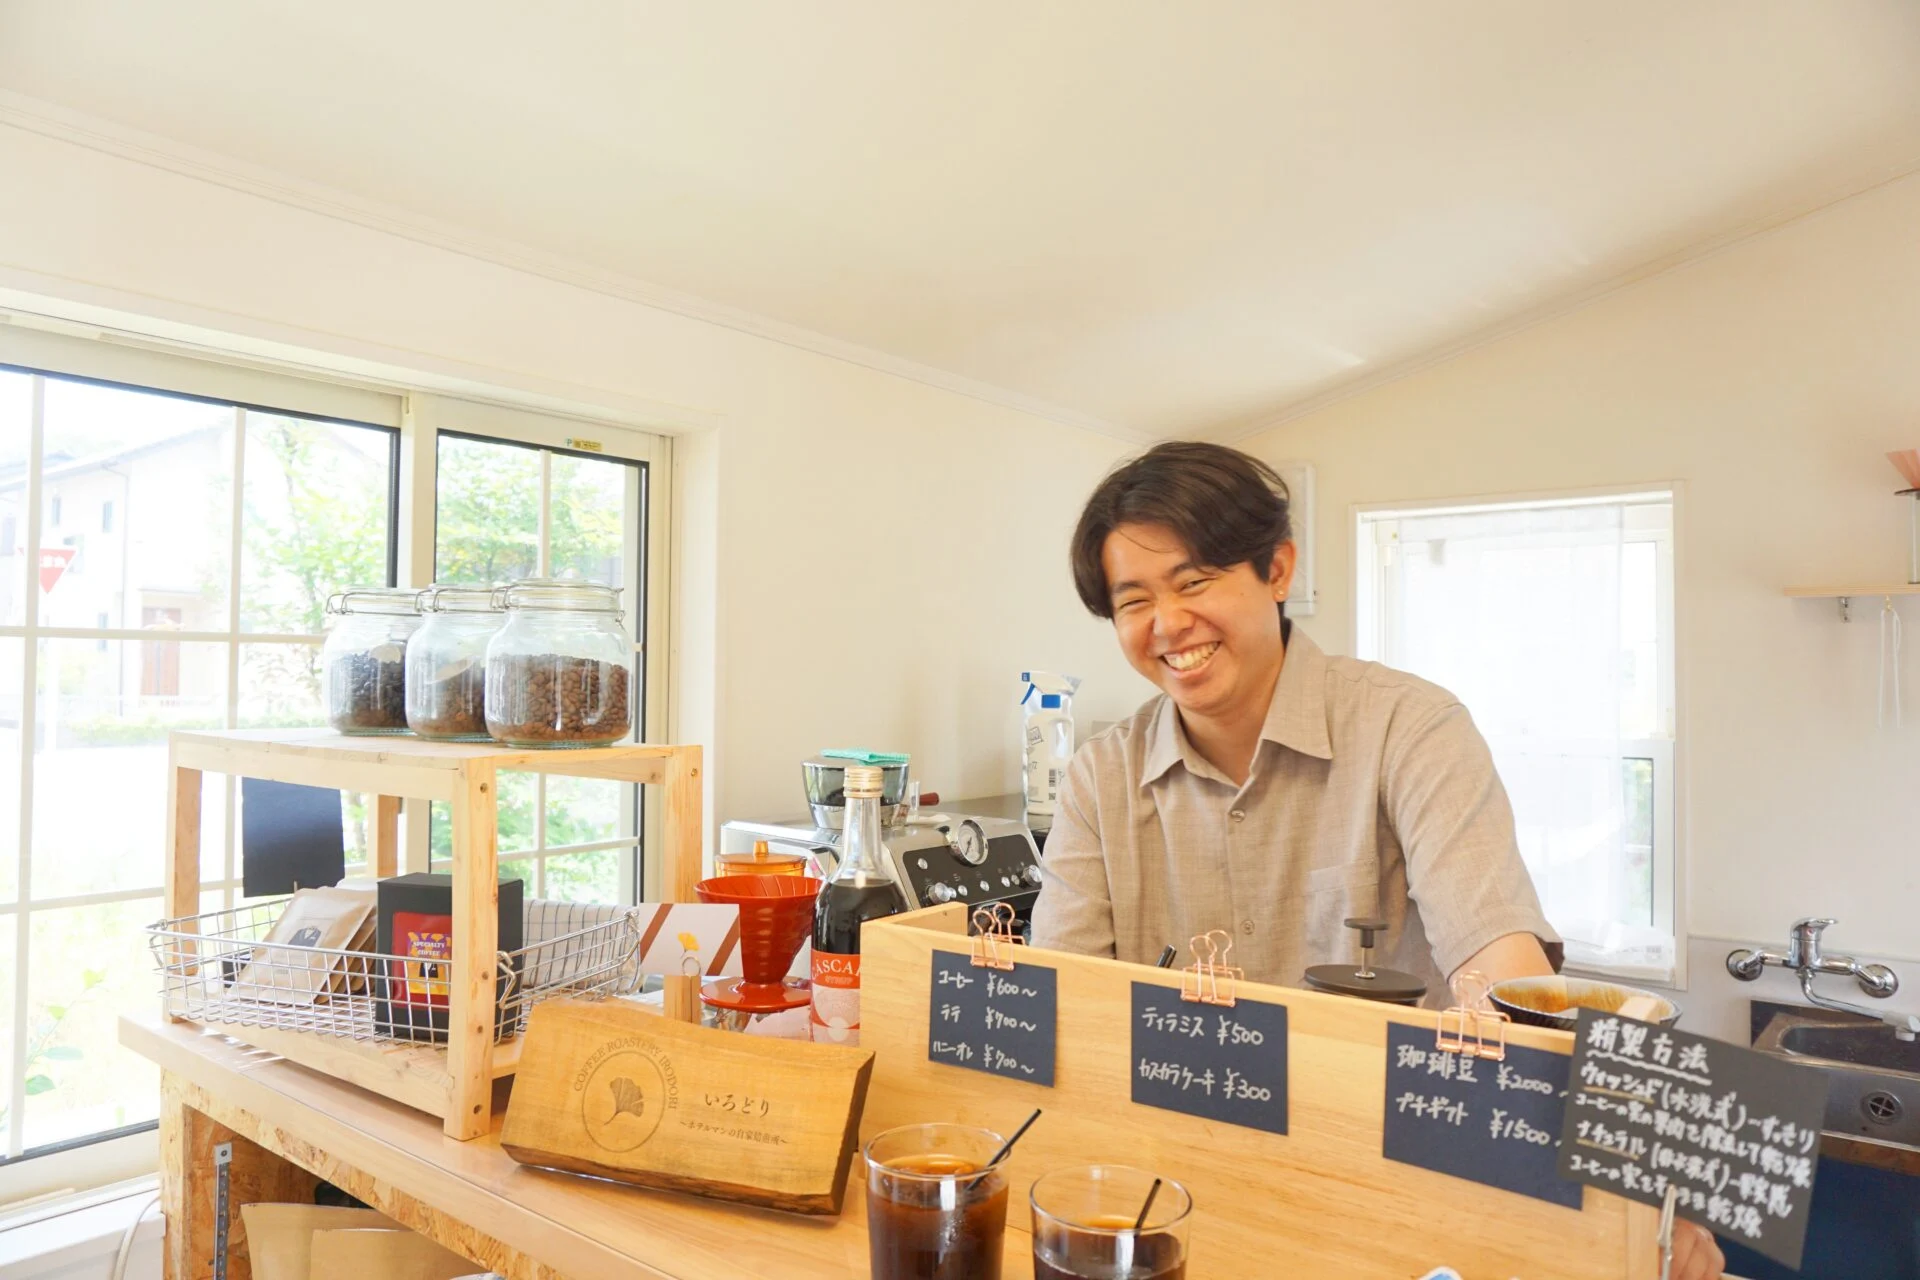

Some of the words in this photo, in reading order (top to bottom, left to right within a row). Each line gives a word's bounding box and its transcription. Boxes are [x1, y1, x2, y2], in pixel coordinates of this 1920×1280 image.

[938, 970, 974, 990] コーヒー
[940, 1003, 962, 1023] ラテ
[1141, 1006, 1205, 1038] ティラミス
[1217, 1014, 1264, 1046] ¥500
[933, 1041, 973, 1061] ハニーオレ
[1586, 1017, 1710, 1074] 精製方法
[573, 1046, 606, 1092] COFFEE
[606, 1037, 662, 1057] ROASTERY
[658, 1054, 680, 1110] IRODORI
[1396, 1044, 1478, 1083] 珈琲豆
[1223, 1068, 1272, 1102] ¥300
[704, 1092, 770, 1118] いろどり
[1395, 1091, 1469, 1126] プチギフト
